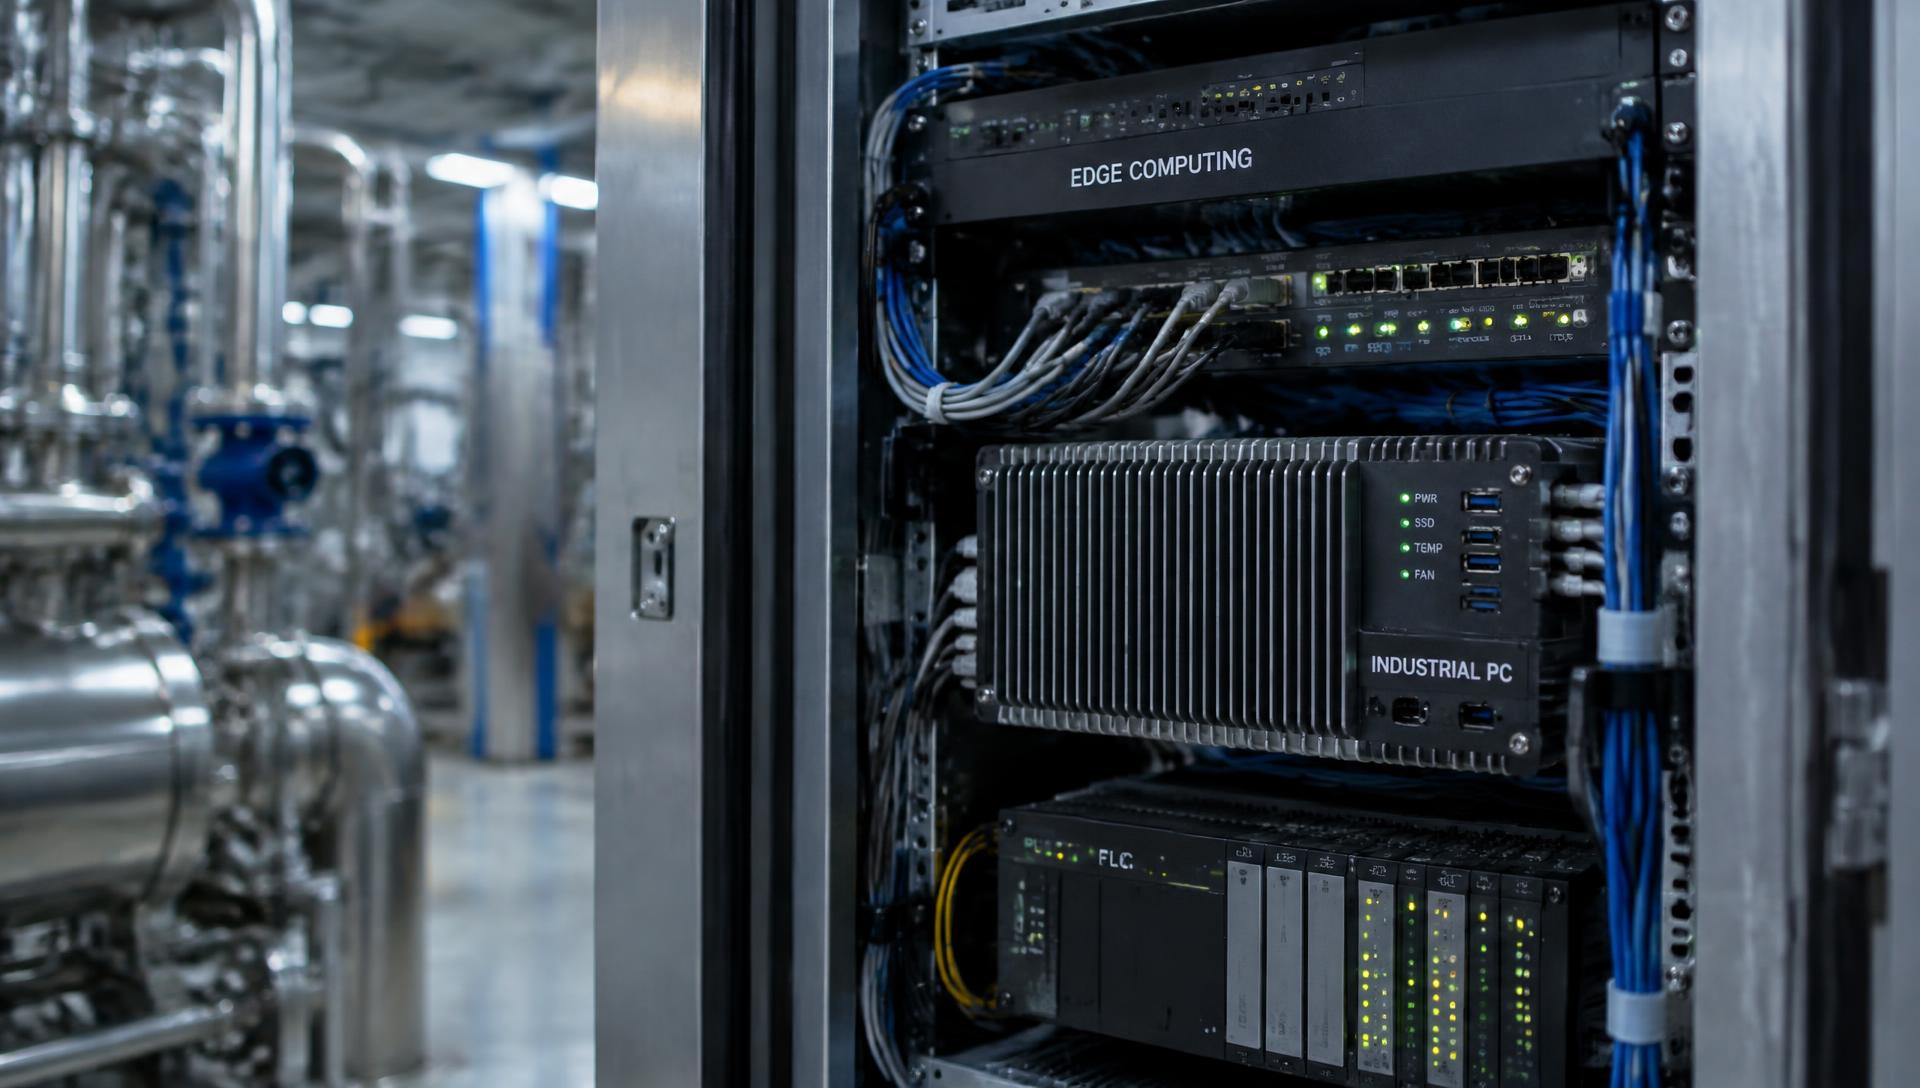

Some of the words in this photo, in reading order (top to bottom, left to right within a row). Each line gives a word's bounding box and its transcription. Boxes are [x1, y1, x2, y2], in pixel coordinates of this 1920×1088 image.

[1070, 162, 1123, 188] EDGE
[1129, 147, 1253, 181] COMPUTING
[1414, 492, 1438, 504] PWR
[1414, 517, 1435, 529] SSD
[1414, 542, 1443, 554] TEMP
[1414, 568, 1436, 581] FAN
[1371, 655, 1481, 681] INDUSTRIAL
[1487, 662, 1513, 683] PC
